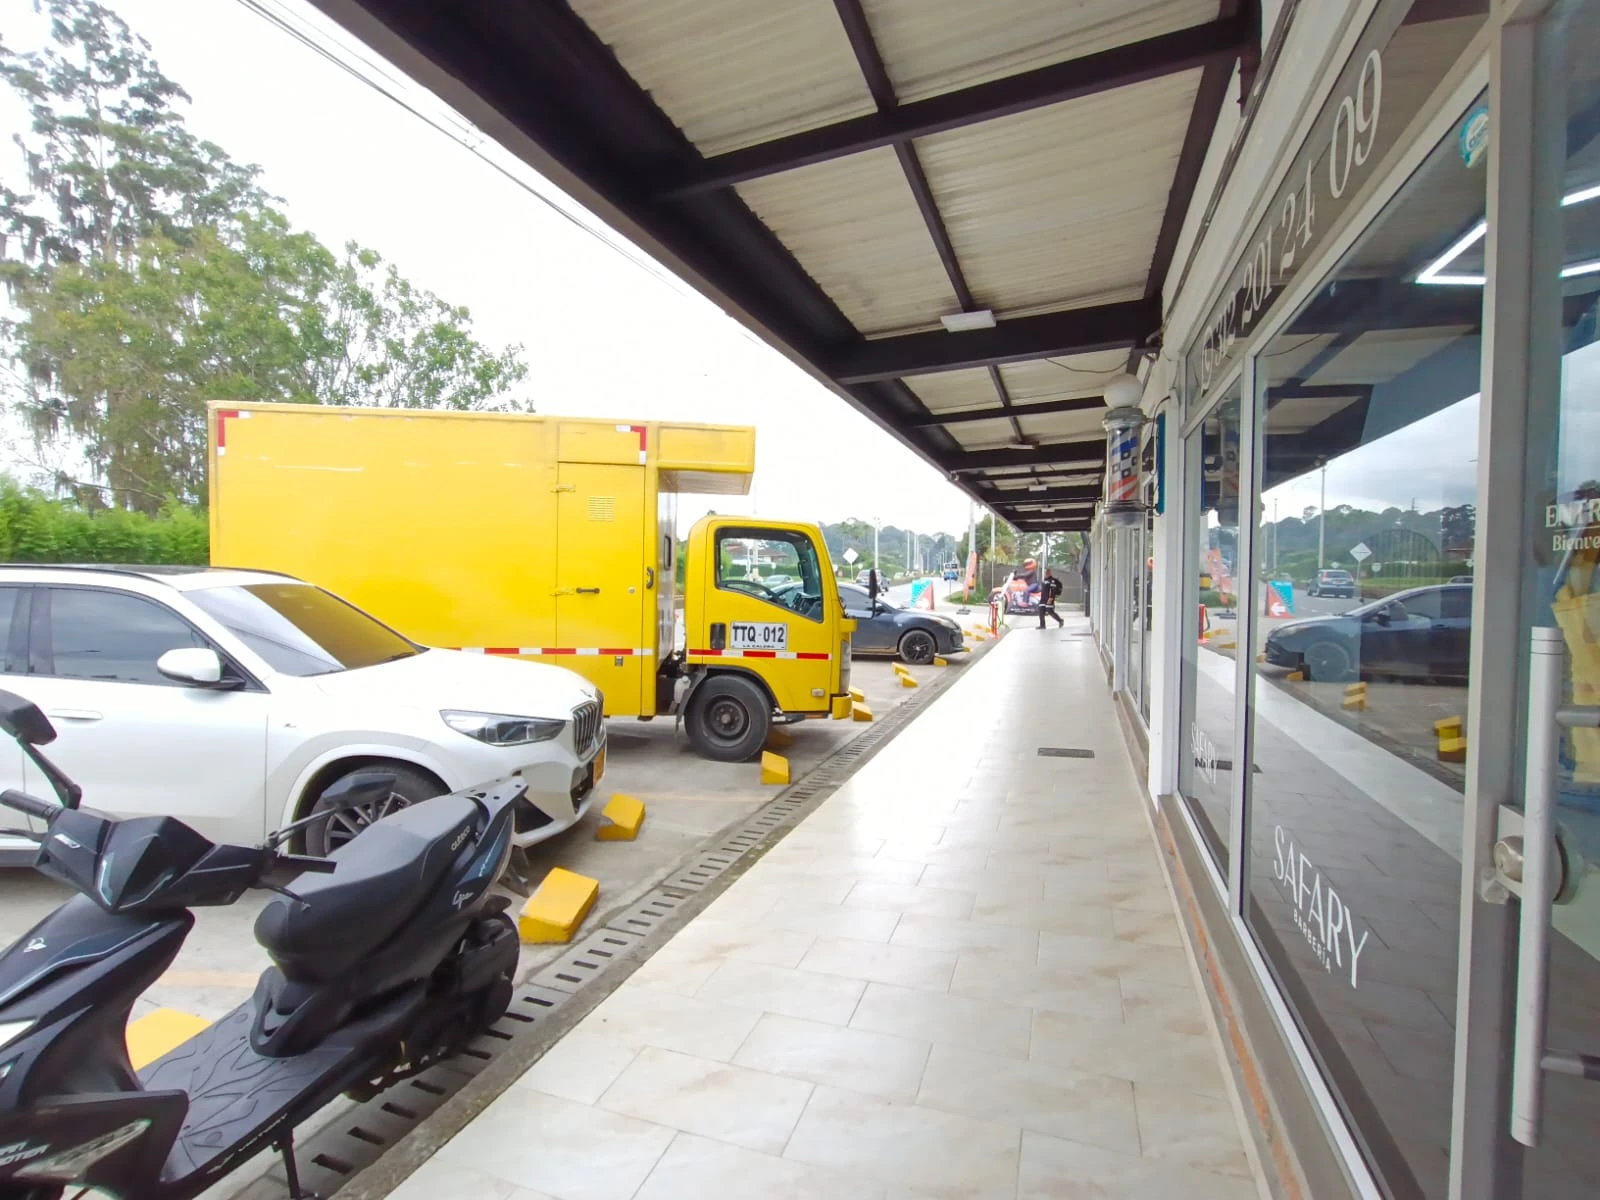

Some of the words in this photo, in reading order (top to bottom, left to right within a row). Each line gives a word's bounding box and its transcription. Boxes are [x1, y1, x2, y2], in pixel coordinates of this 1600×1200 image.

[1241, 225, 1272, 332] 201
[1279, 159, 1316, 280] 24
[1329, 49, 1382, 199] 09
[1273, 824, 1369, 989] SAFARY
